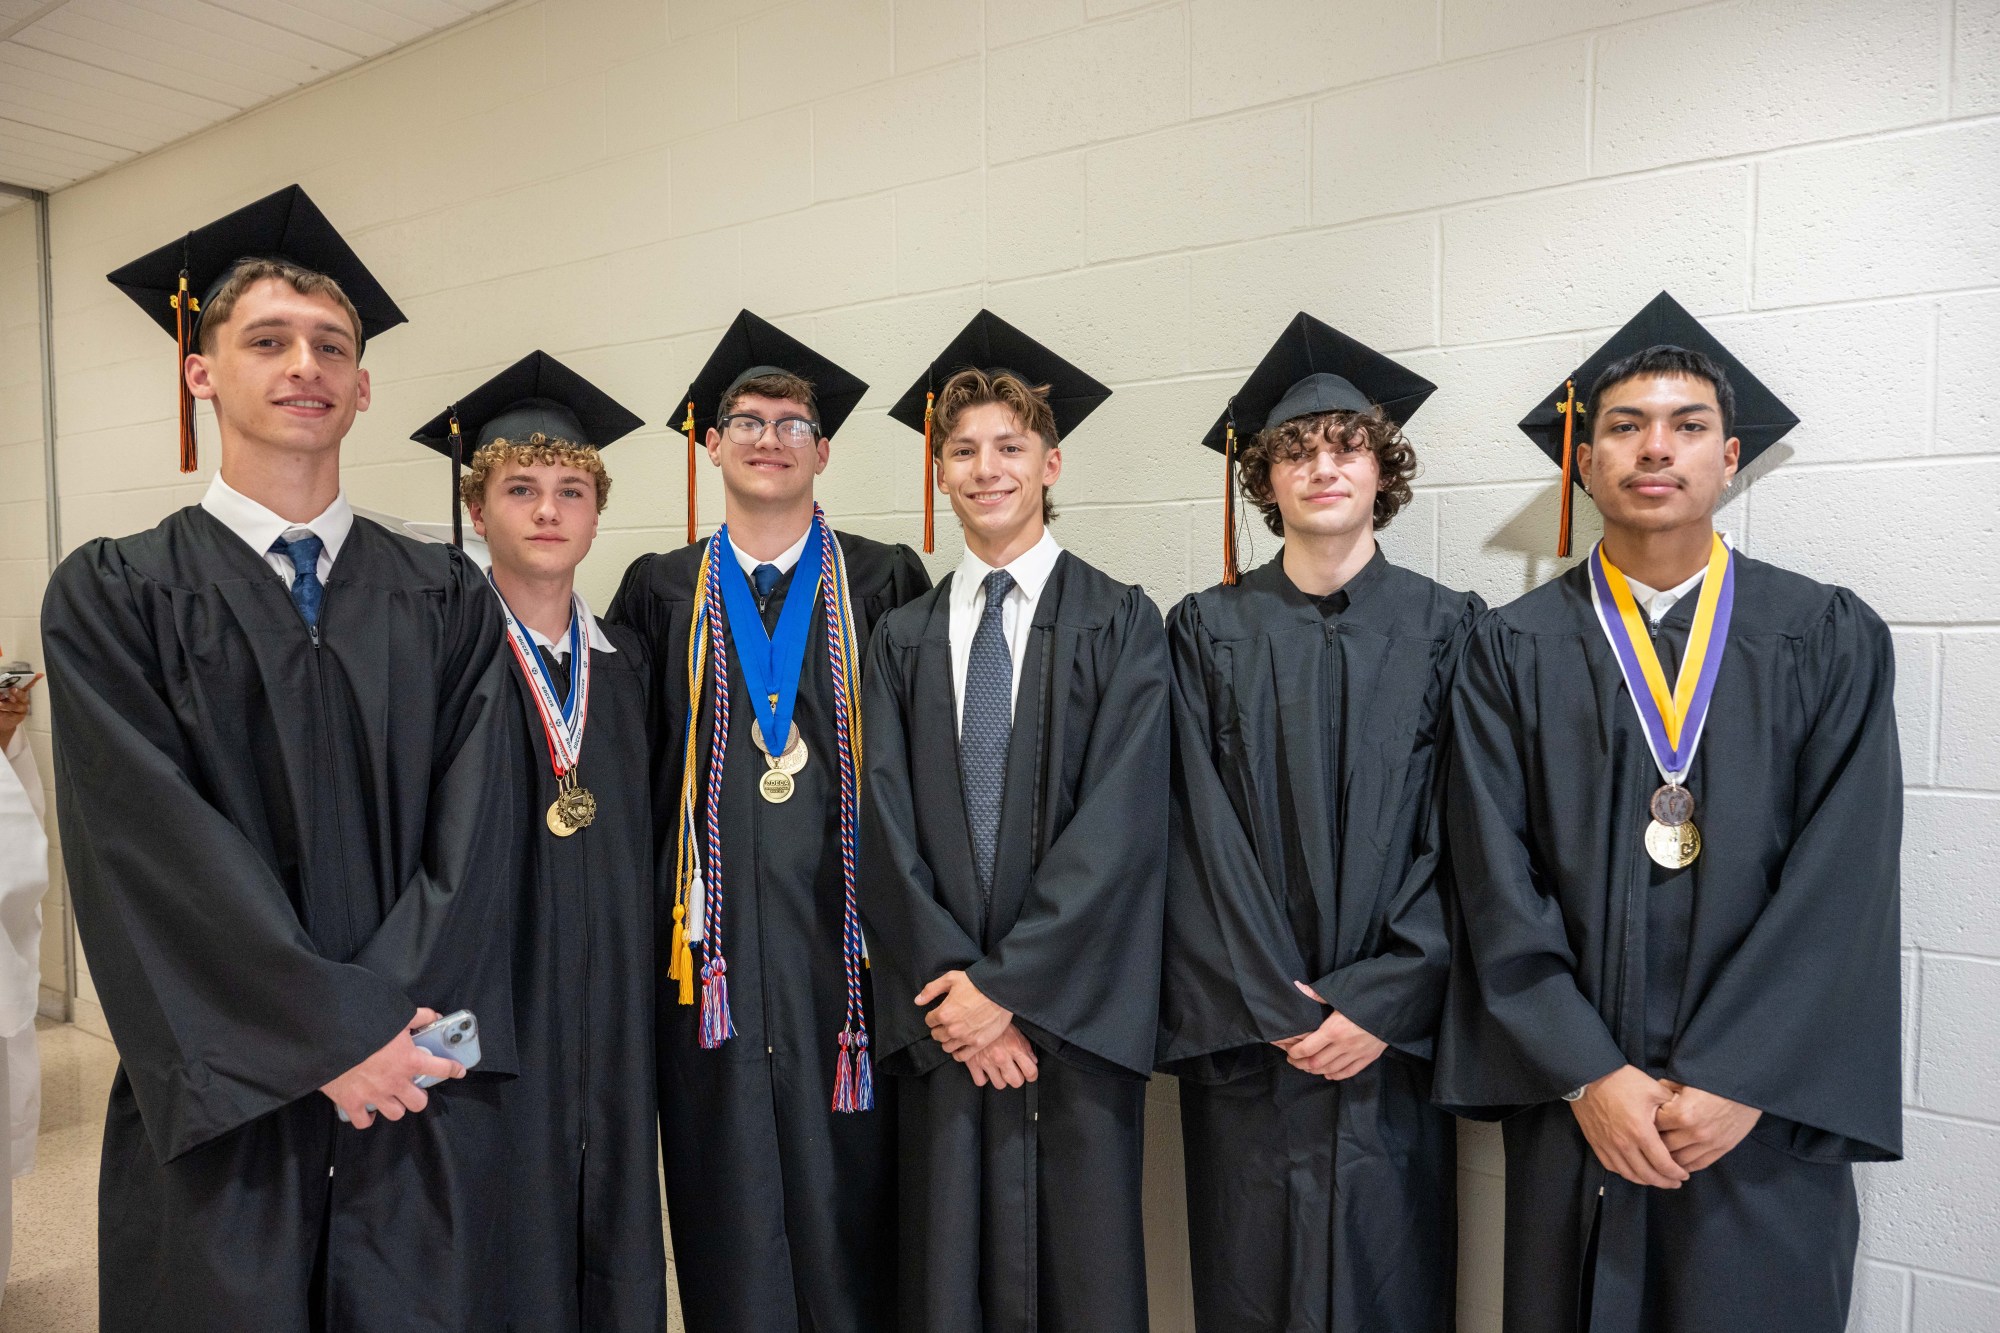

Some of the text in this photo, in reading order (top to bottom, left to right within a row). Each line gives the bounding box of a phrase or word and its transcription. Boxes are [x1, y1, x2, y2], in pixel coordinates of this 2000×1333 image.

[516, 634, 530, 656] SOCCER
[541, 685, 554, 708] SOCCER
[573, 727, 582, 750] SOCCER
